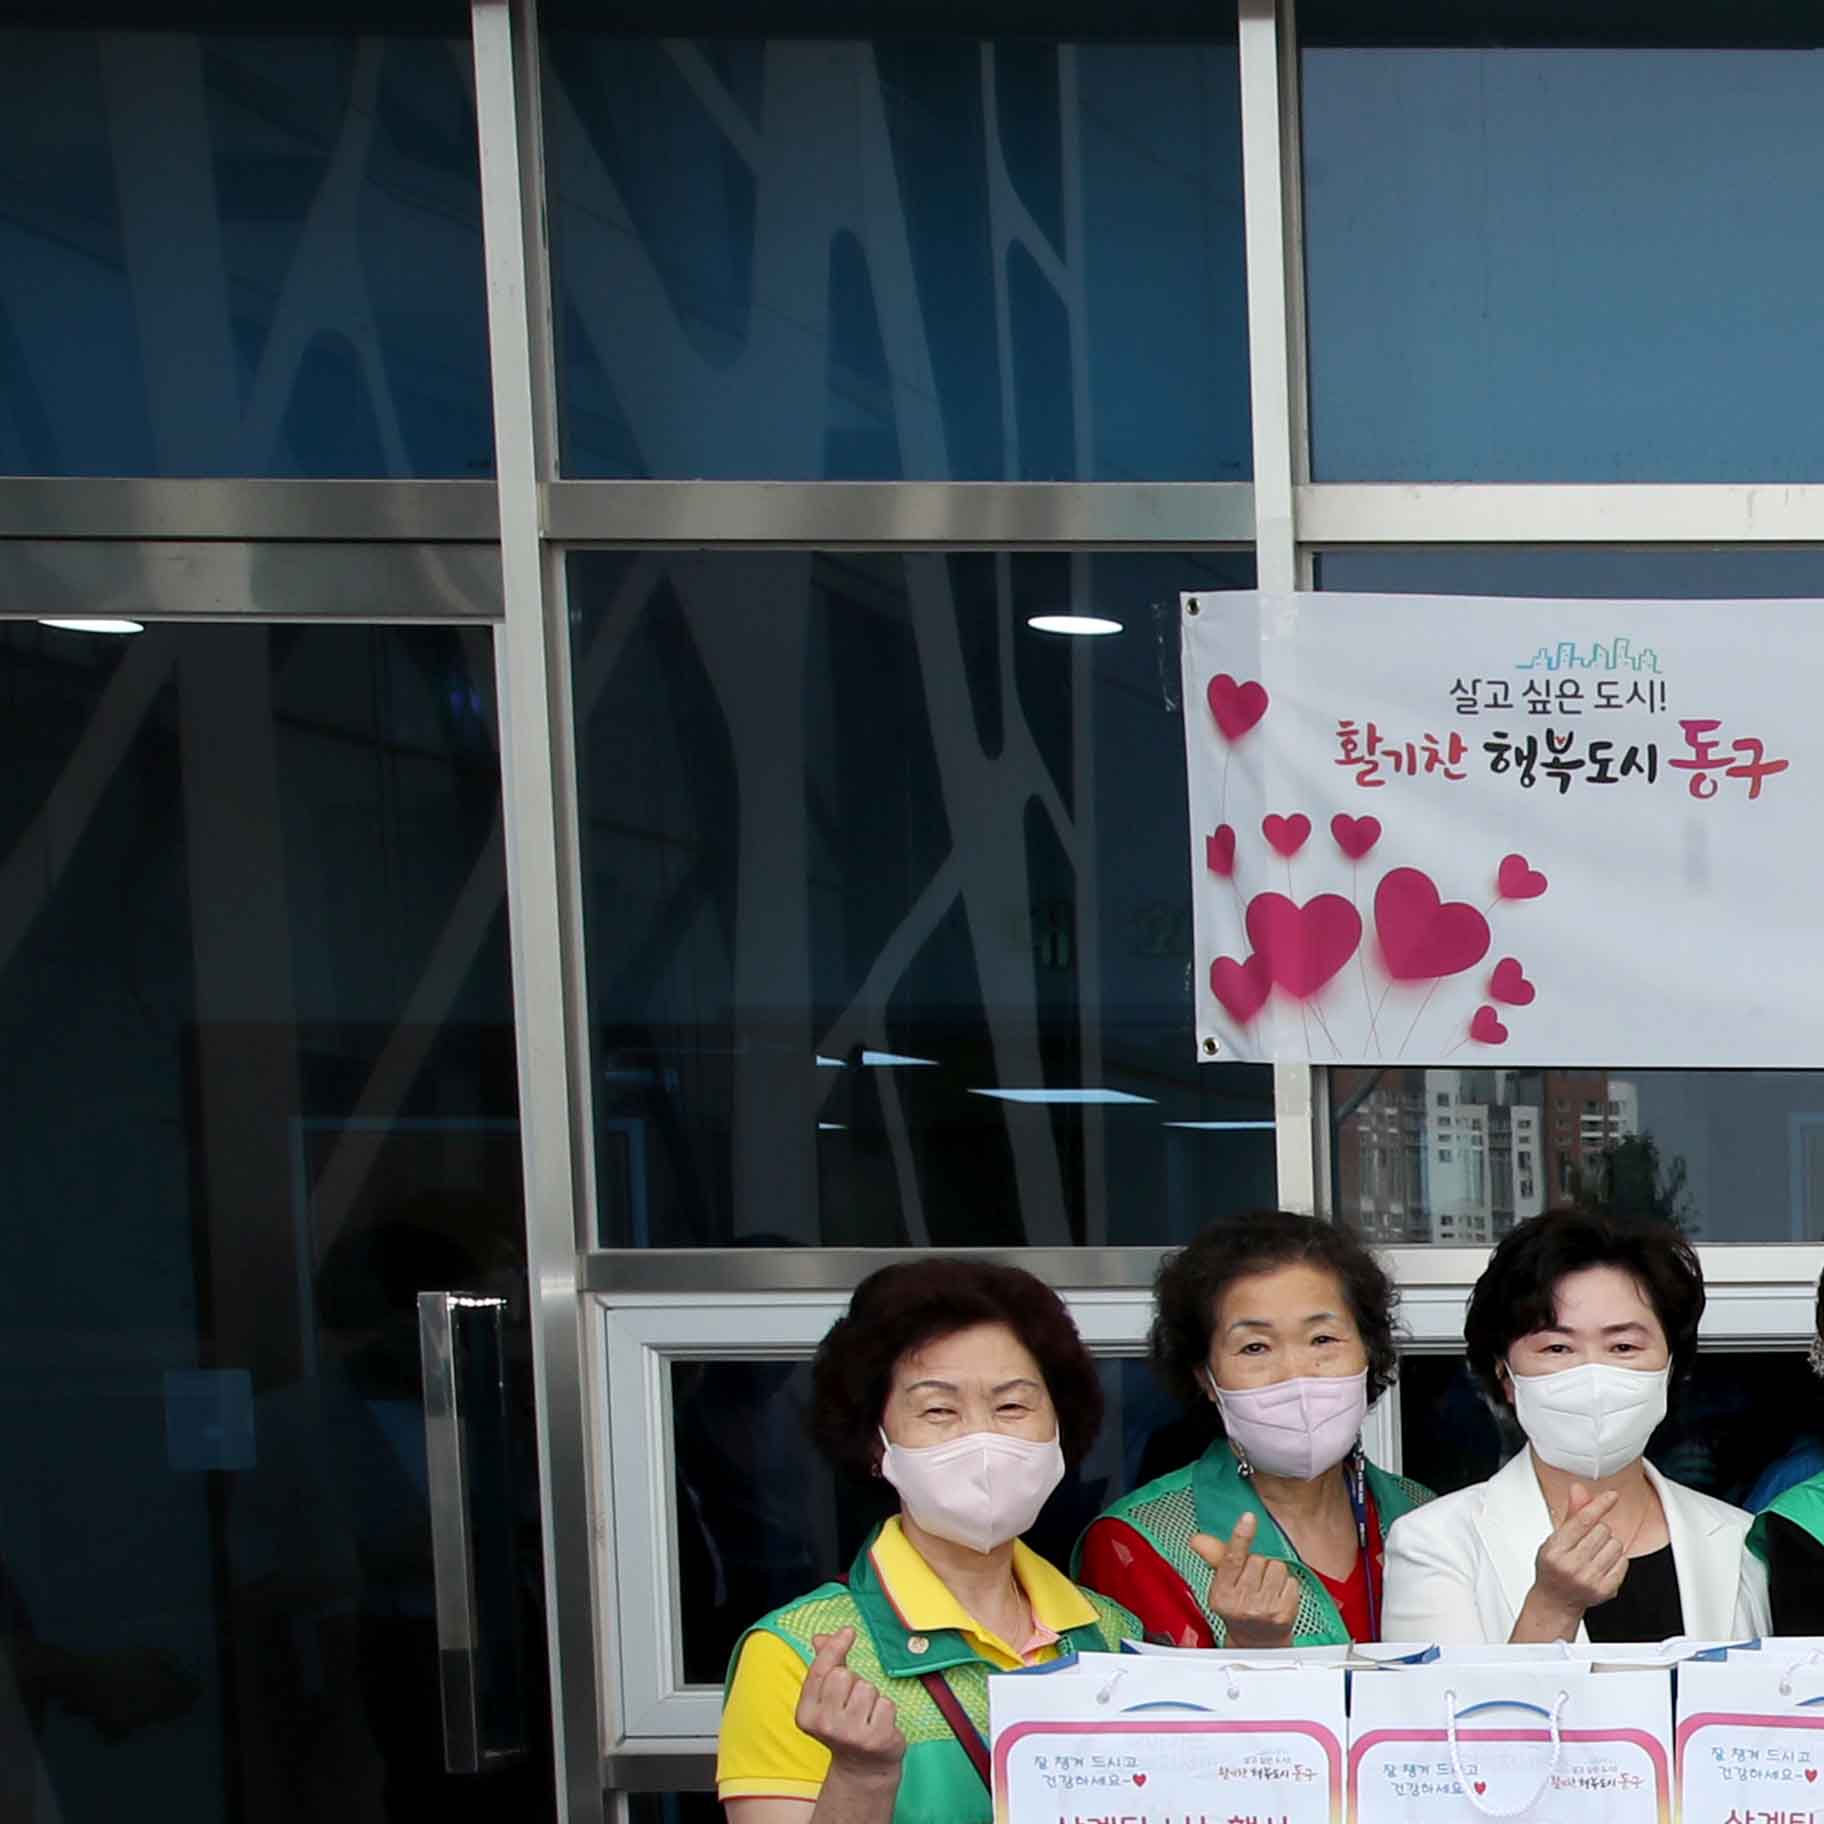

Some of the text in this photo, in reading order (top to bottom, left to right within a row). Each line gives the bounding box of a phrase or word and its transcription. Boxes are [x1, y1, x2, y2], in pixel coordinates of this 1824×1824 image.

[1450, 678, 1666, 715] 살고 싶은 도시!
[1334, 720, 1789, 800] 활기찬 행복도시 동구
